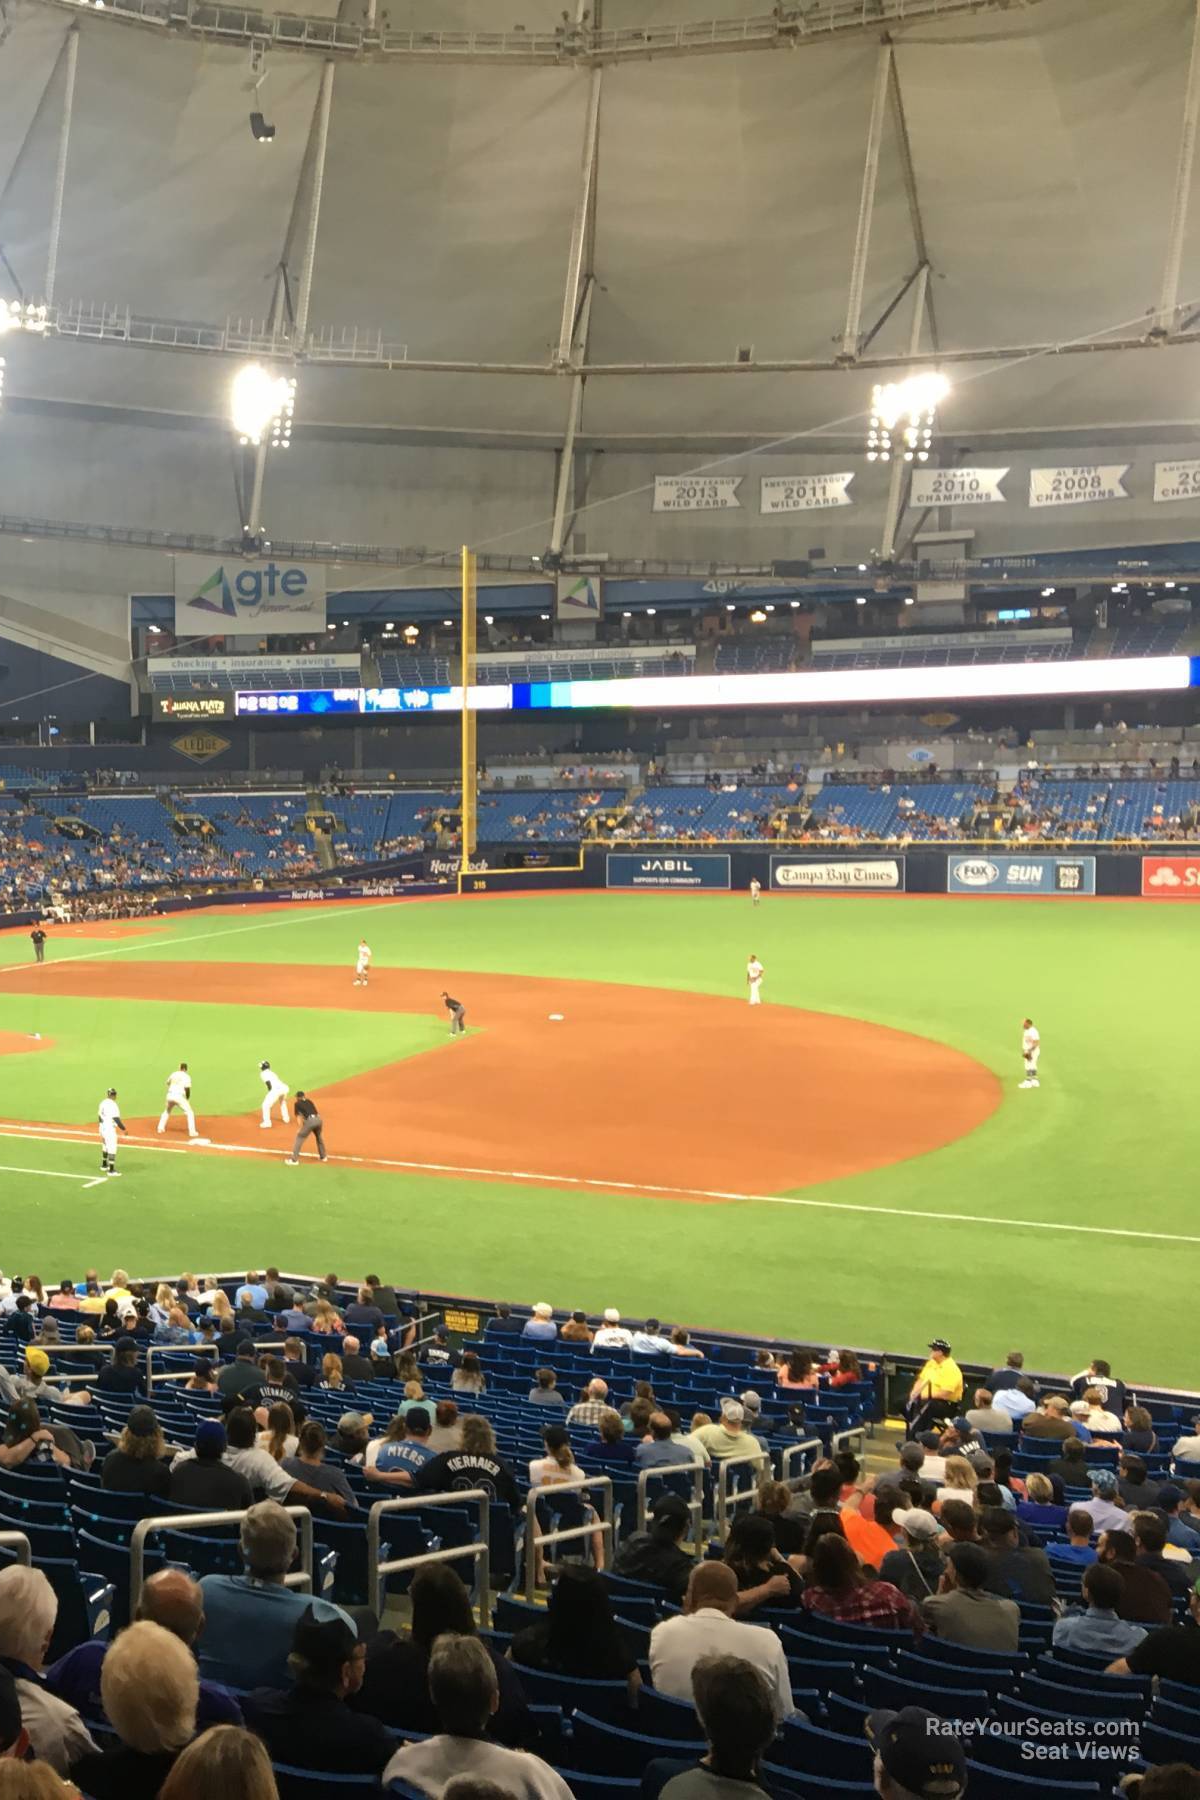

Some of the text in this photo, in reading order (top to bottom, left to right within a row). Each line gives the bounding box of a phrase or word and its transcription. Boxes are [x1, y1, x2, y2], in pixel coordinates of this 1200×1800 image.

[932, 479, 981, 493] 2010
[1052, 474, 1102, 491] 2008
[675, 486, 719, 499] 2013
[784, 485, 828, 499] 2011
[916, 493, 992, 502] CHAMPIONS
[1036, 488, 1116, 503] CHAMPIONS
[700, 499, 728, 507] CARD
[806, 497, 839, 506] CARD
[234, 562, 308, 606] gte
[171, 656, 336, 671] checking insurance savings
[430, 859, 459, 873] Hard
[641, 860, 693, 871] JABIL
[964, 865, 988, 876] FOX
[782, 866, 893, 884] Tampa Bay Times
[1007, 865, 1043, 881] SUN
[292, 890, 324, 900] Hard Rock
[362, 886, 394, 896] Hard Rock
[388, 1446, 426, 1467] MYERS
[446, 1455, 501, 1476] KIERMAIER
